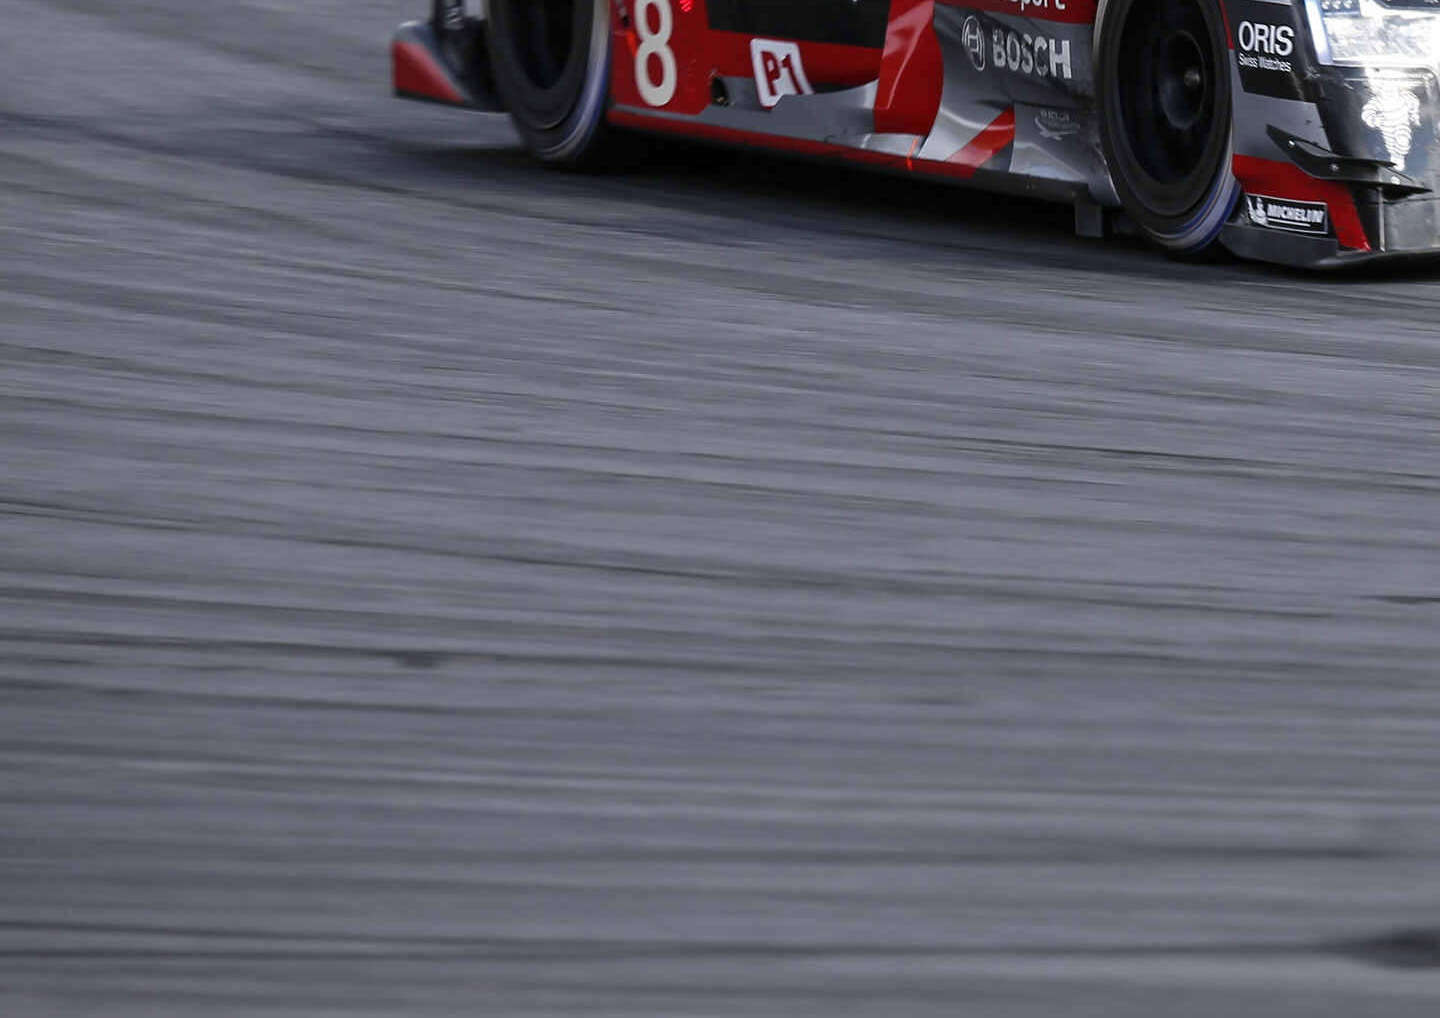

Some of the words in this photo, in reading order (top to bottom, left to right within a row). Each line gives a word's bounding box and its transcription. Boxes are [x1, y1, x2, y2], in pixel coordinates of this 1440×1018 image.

[992, 28, 1072, 79] BOSCH
[1238, 20, 1294, 56] ORIS
[761, 50, 804, 97] P1
[1267, 203, 1325, 224] MICHELIN
